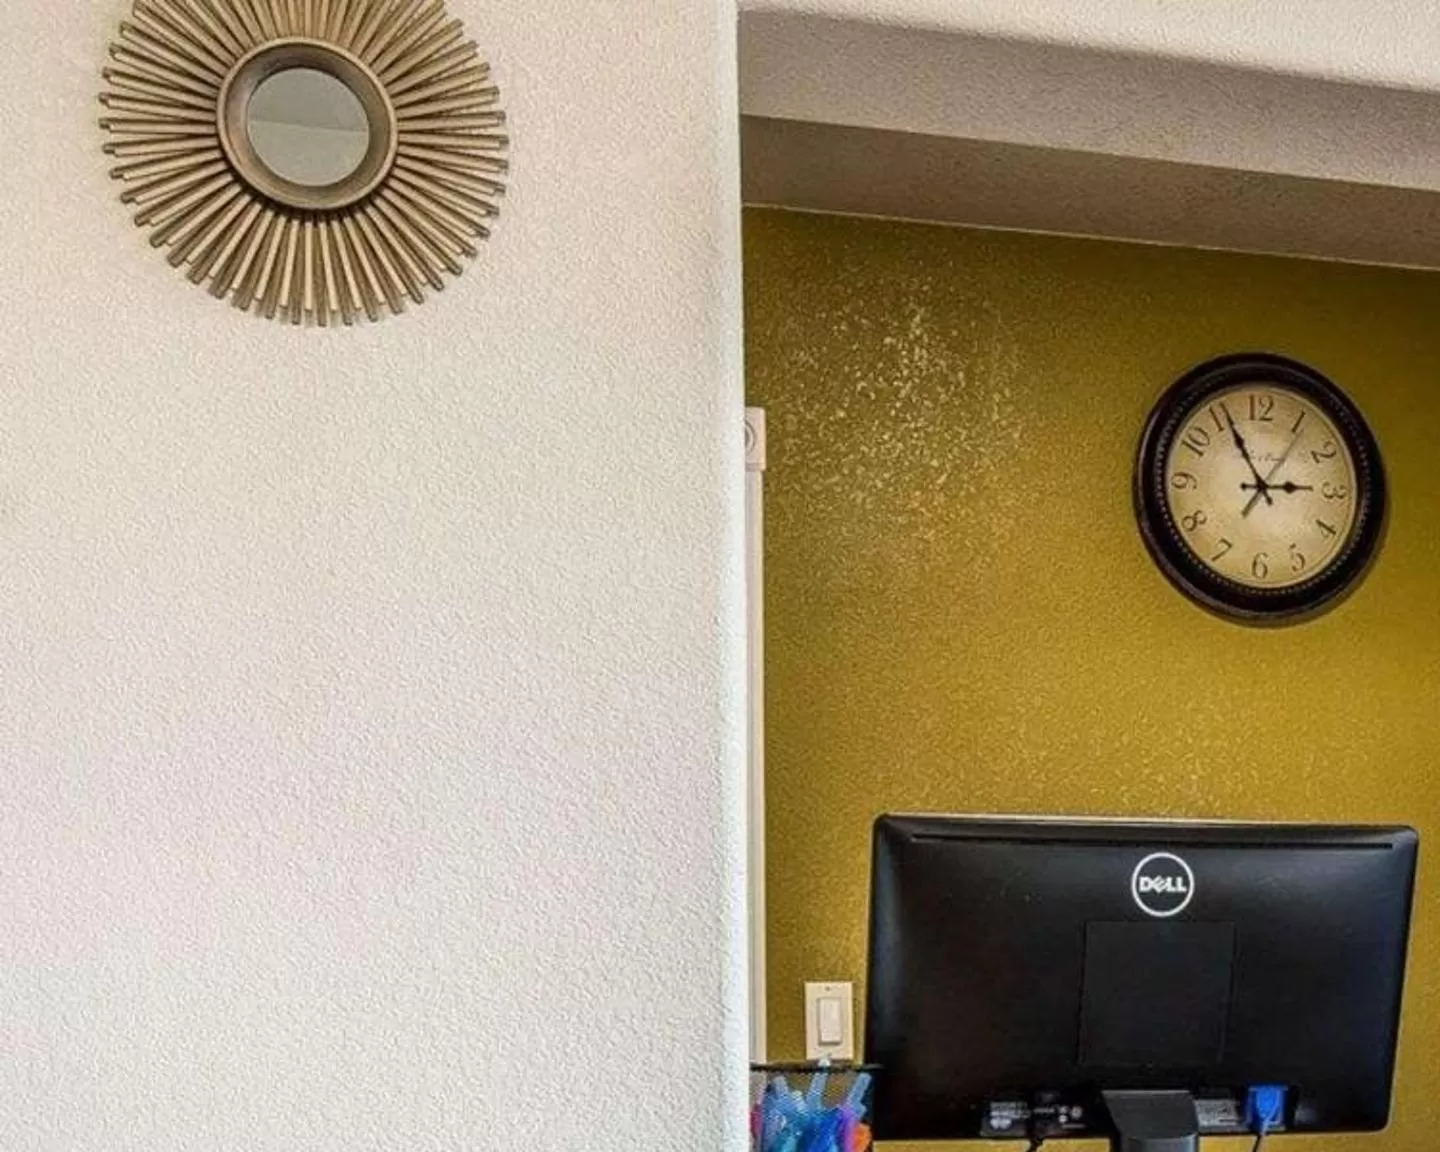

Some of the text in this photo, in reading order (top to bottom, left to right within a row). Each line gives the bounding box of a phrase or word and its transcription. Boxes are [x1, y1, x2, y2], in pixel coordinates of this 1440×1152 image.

[1209, 403, 1235, 432] 1
[1249, 394, 1275, 422] 12
[1291, 411, 1306, 433] 1
[1182, 427, 1210, 457] 10
[1311, 441, 1337, 464] 2
[1171, 471, 1198, 491] 9
[1321, 482, 1346, 500] 3
[1181, 510, 1207, 532] 8
[1315, 518, 1337, 538] 4
[1211, 538, 1233, 562] 7
[1288, 544, 1306, 572] 5
[1252, 552, 1269, 579] 6
[1139, 876, 1187, 893] DELL
